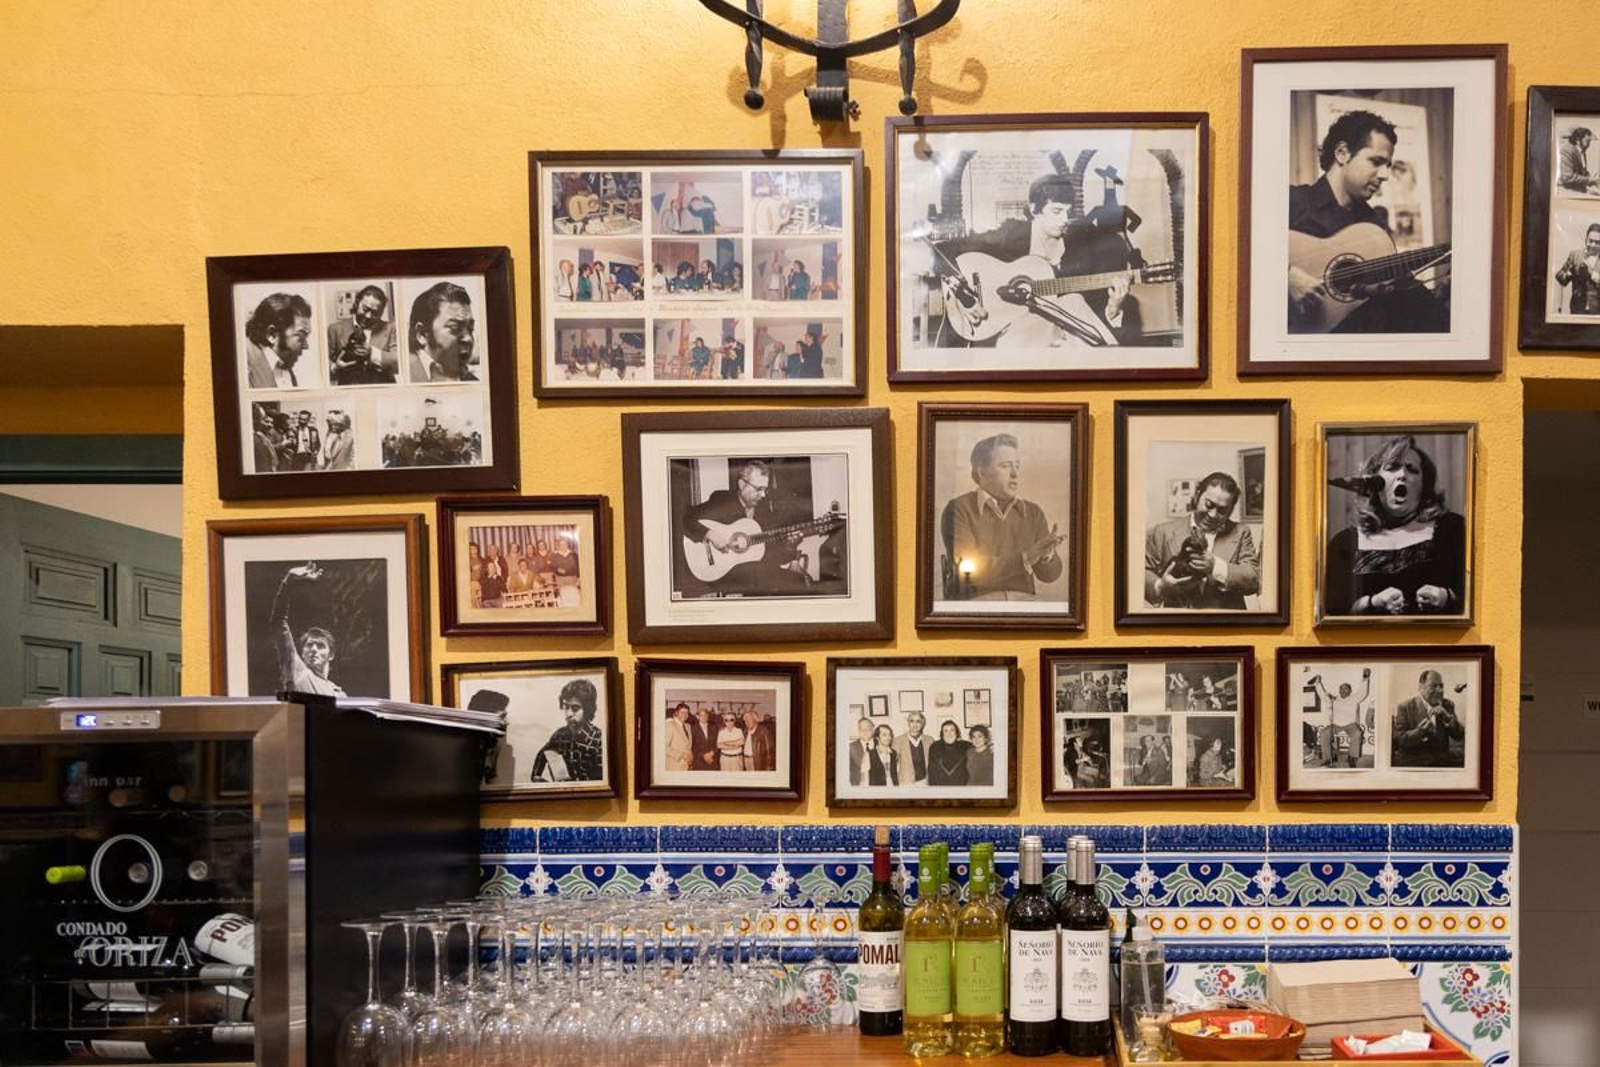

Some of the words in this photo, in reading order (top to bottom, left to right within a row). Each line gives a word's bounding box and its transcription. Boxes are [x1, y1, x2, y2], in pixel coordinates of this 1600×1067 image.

[1587, 700, 1600, 712] W
[57, 922, 127, 936] CONDADO
[88, 936, 194, 967] ORIZA
